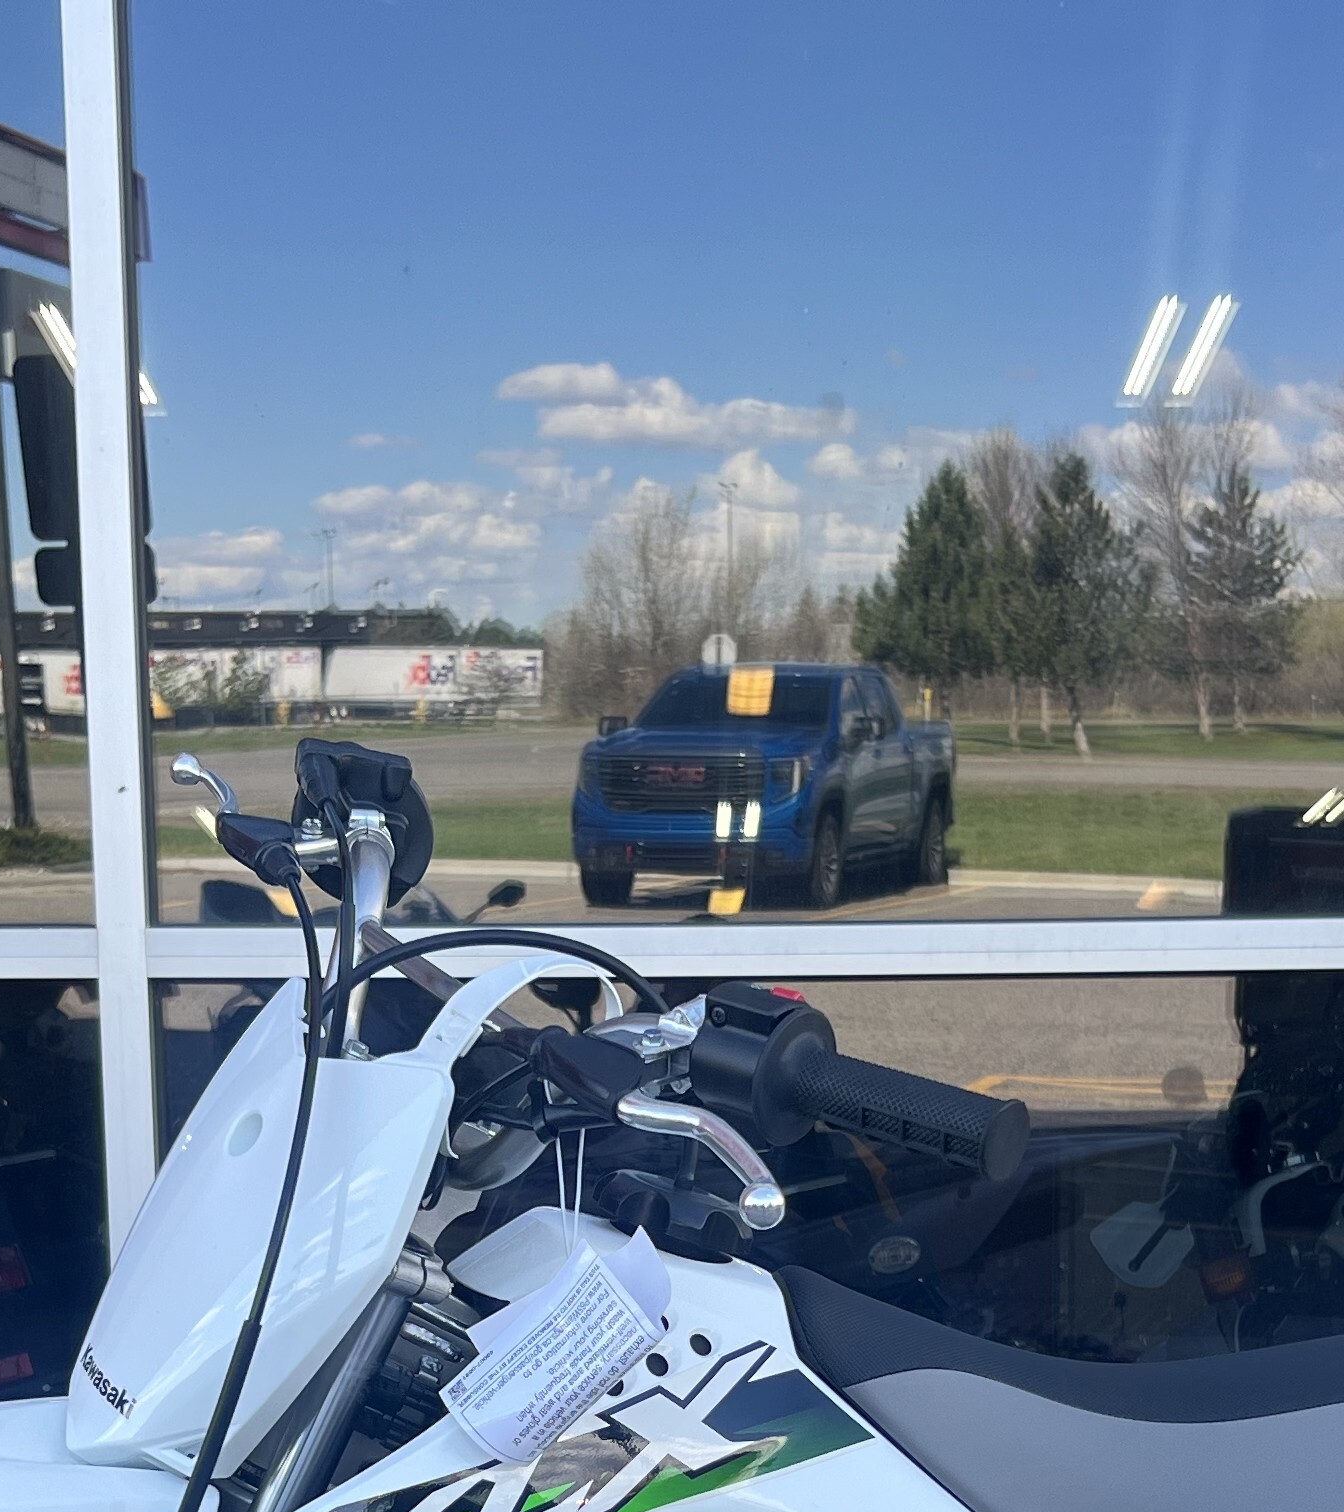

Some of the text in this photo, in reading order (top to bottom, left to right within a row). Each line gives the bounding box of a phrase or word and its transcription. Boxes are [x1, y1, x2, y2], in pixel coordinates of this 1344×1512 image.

[604, 1308, 625, 1331] wash
[571, 1330, 589, 1352] your
[589, 1326, 606, 1347] your
[568, 1345, 593, 1369] hands
[80, 1343, 137, 1420] Kawasaki
[563, 1387, 581, 1407] your
[515, 1400, 537, 1423] when
